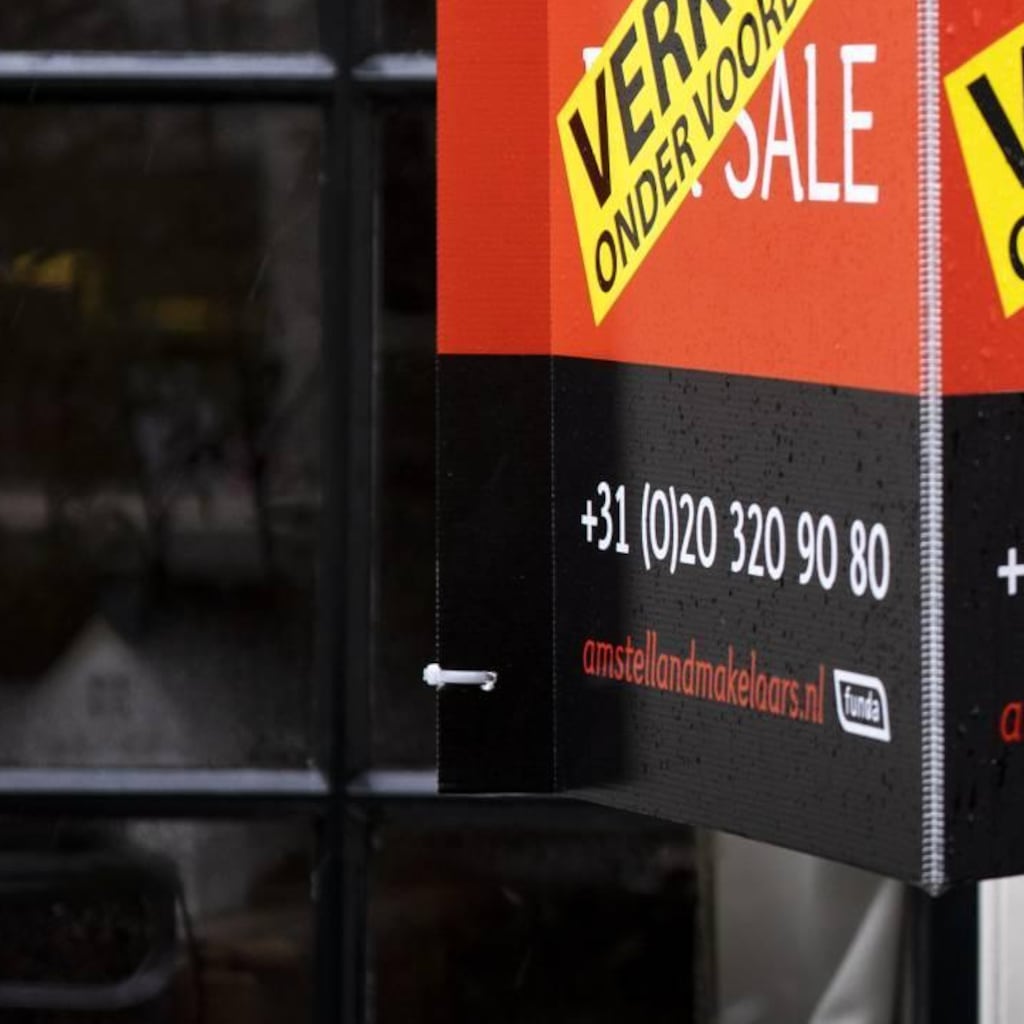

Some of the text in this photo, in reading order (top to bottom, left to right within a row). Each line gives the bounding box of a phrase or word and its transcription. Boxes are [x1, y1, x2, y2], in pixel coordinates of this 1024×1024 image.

[595, 114, 696, 293] ONDER
[581, 481, 890, 600] +31 (0)20 320 90 80
[582, 629, 826, 724] amstellandmakelaars.nl
[843, 686, 881, 723] funda
